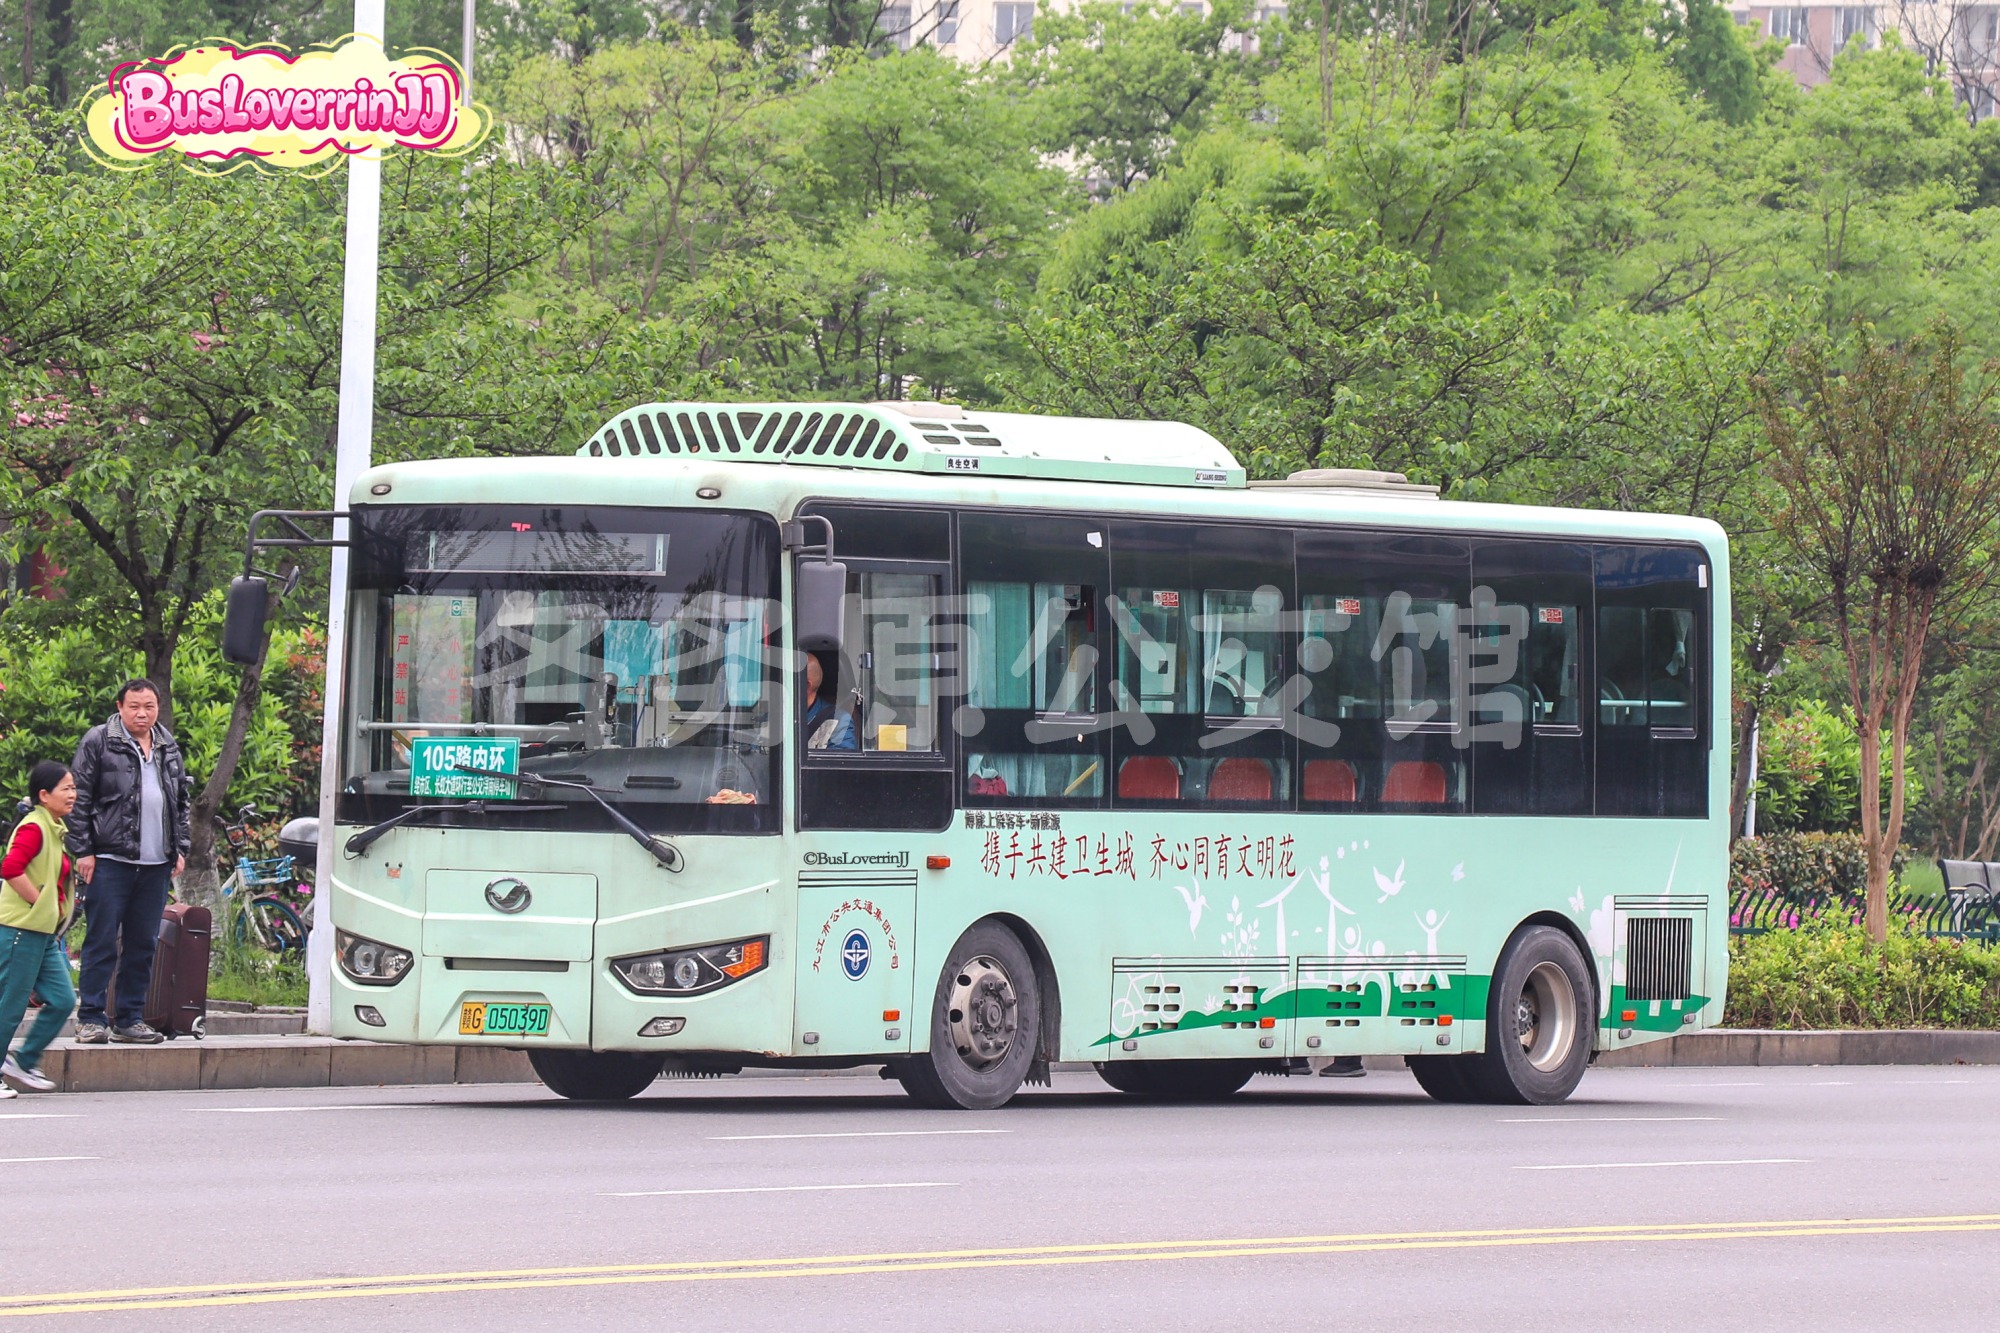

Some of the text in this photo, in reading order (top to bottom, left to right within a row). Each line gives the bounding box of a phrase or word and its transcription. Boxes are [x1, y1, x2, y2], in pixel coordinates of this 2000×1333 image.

[947, 458, 979, 469] 良生空调
[423, 744, 506, 772] 105路内环
[981, 830, 1297, 881] 携手共建卫生城 齐心同育文明花
